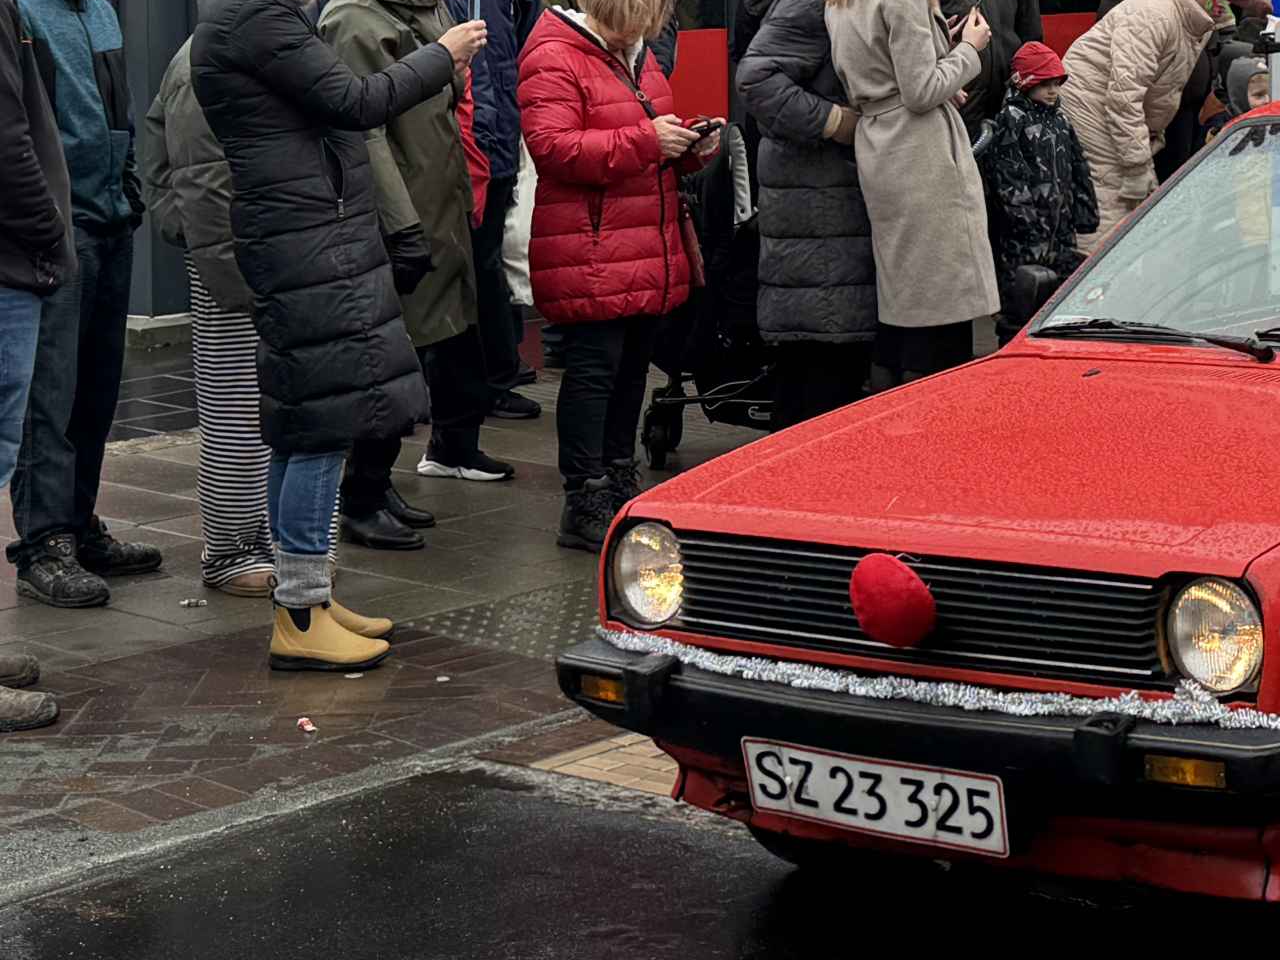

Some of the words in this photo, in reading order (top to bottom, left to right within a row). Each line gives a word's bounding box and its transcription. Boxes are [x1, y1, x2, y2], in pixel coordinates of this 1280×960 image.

[755, 750, 819, 809] SZ
[829, 766, 887, 821] 23
[900, 777, 994, 839] 325
